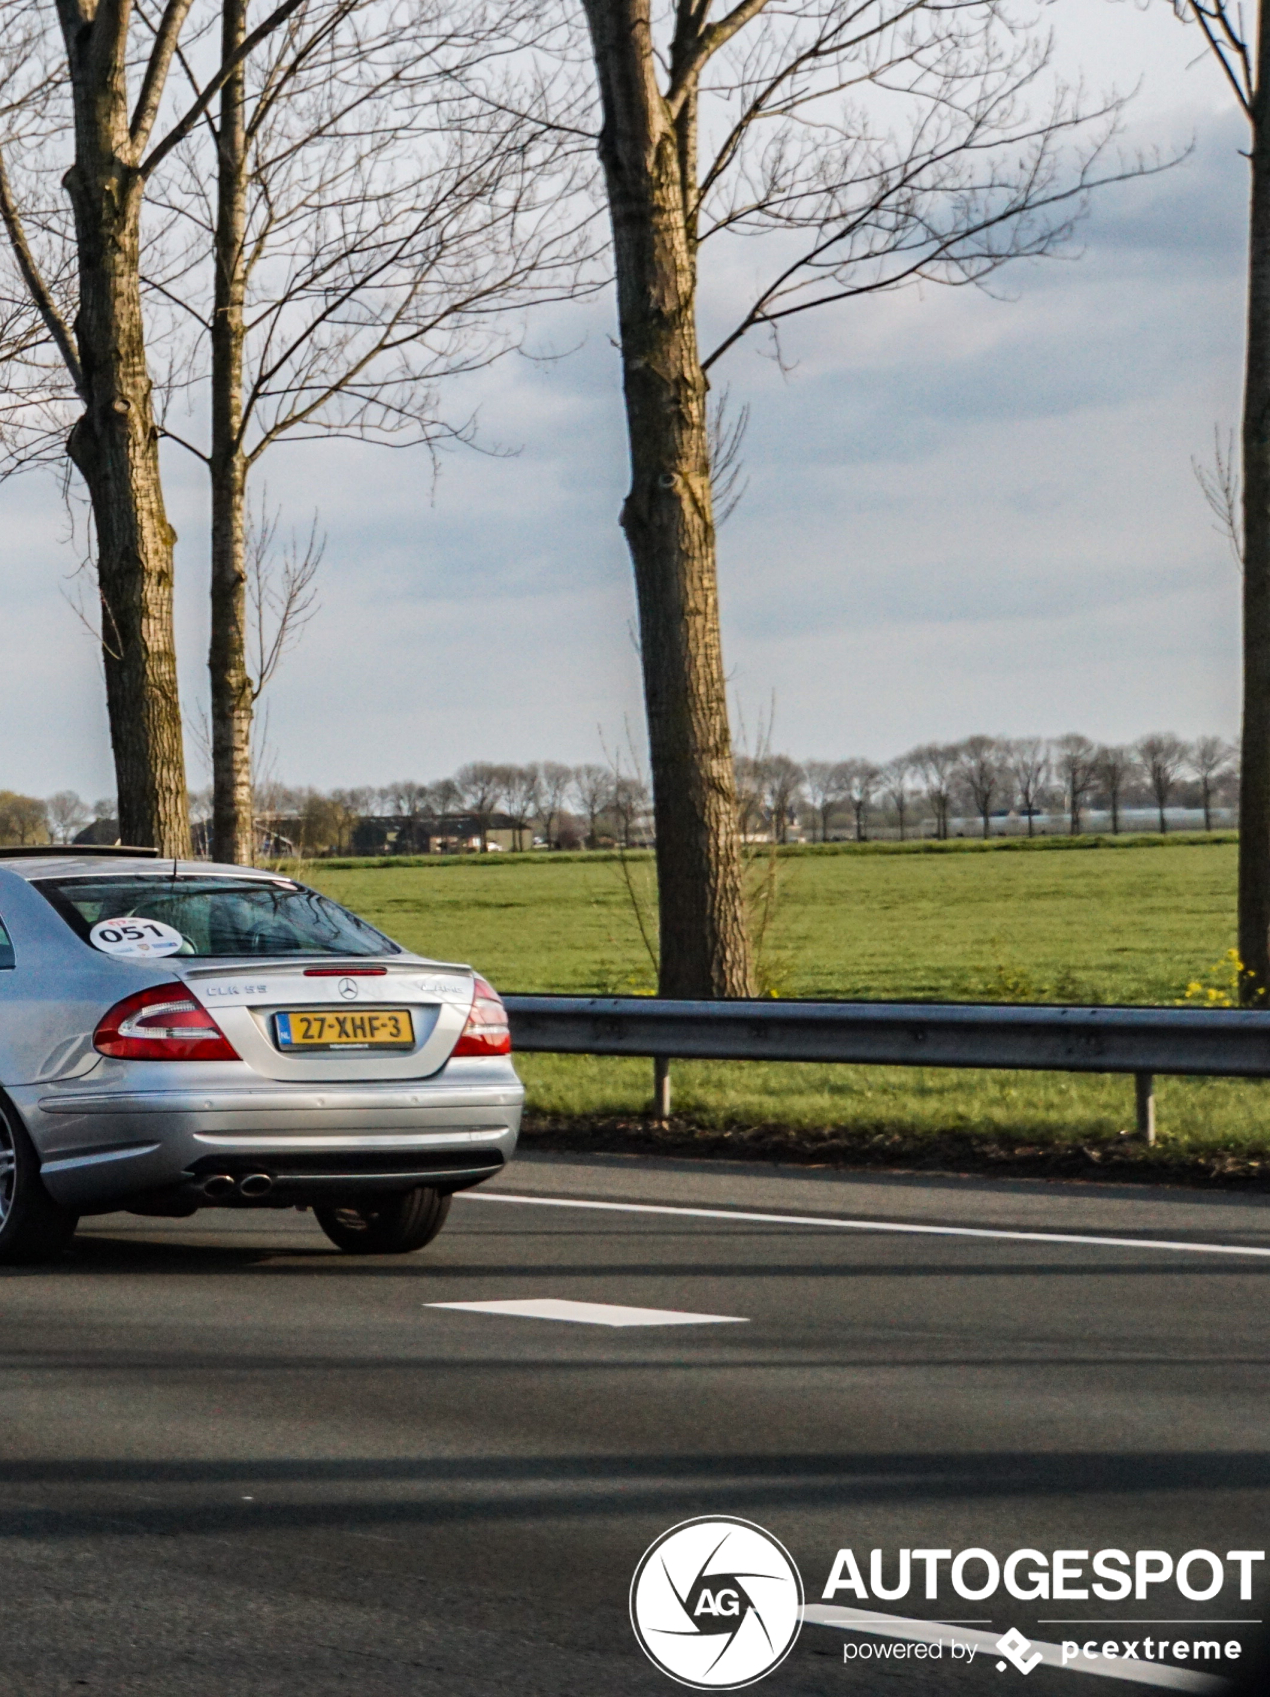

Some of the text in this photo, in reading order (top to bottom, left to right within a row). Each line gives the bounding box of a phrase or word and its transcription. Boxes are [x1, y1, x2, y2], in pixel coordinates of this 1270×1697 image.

[98, 923, 164, 943] 051
[206, 986, 240, 997] CLK
[280, 1030, 290, 1040] NL
[299, 1015, 401, 1040] 27-XHF-3
